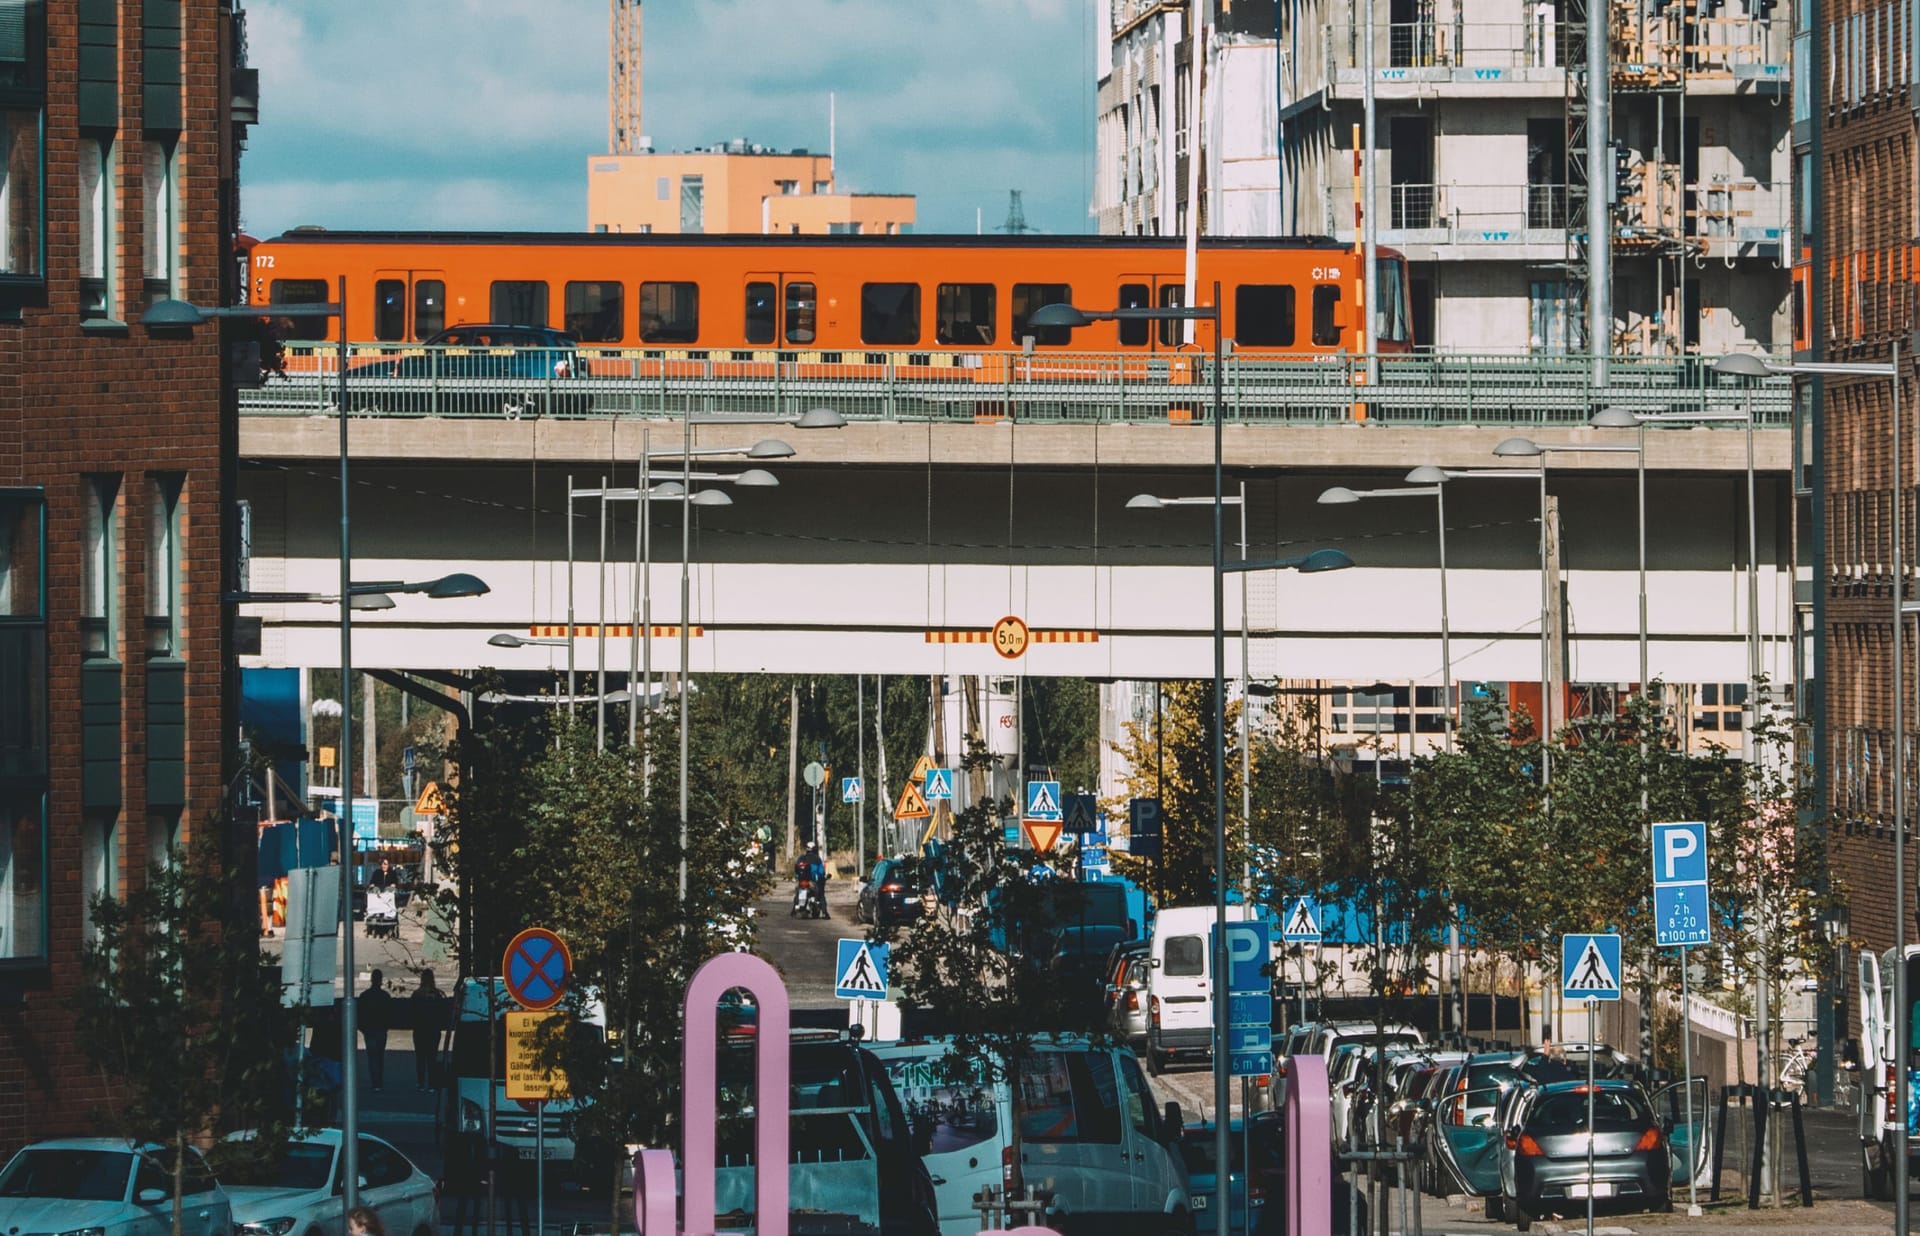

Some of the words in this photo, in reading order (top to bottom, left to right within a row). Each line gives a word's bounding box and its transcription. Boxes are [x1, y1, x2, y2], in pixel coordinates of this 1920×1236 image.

[1382, 69, 1405, 79] YIT
[1474, 69, 1502, 80] YIT
[1482, 231, 1509, 241] YIT
[255, 255, 275, 269] 172
[1137, 801, 1158, 831] P
[1664, 828, 1698, 879] P
[1669, 930, 1686, 942] 100
[1689, 930, 1698, 941] m
[1226, 928, 1261, 987] P
